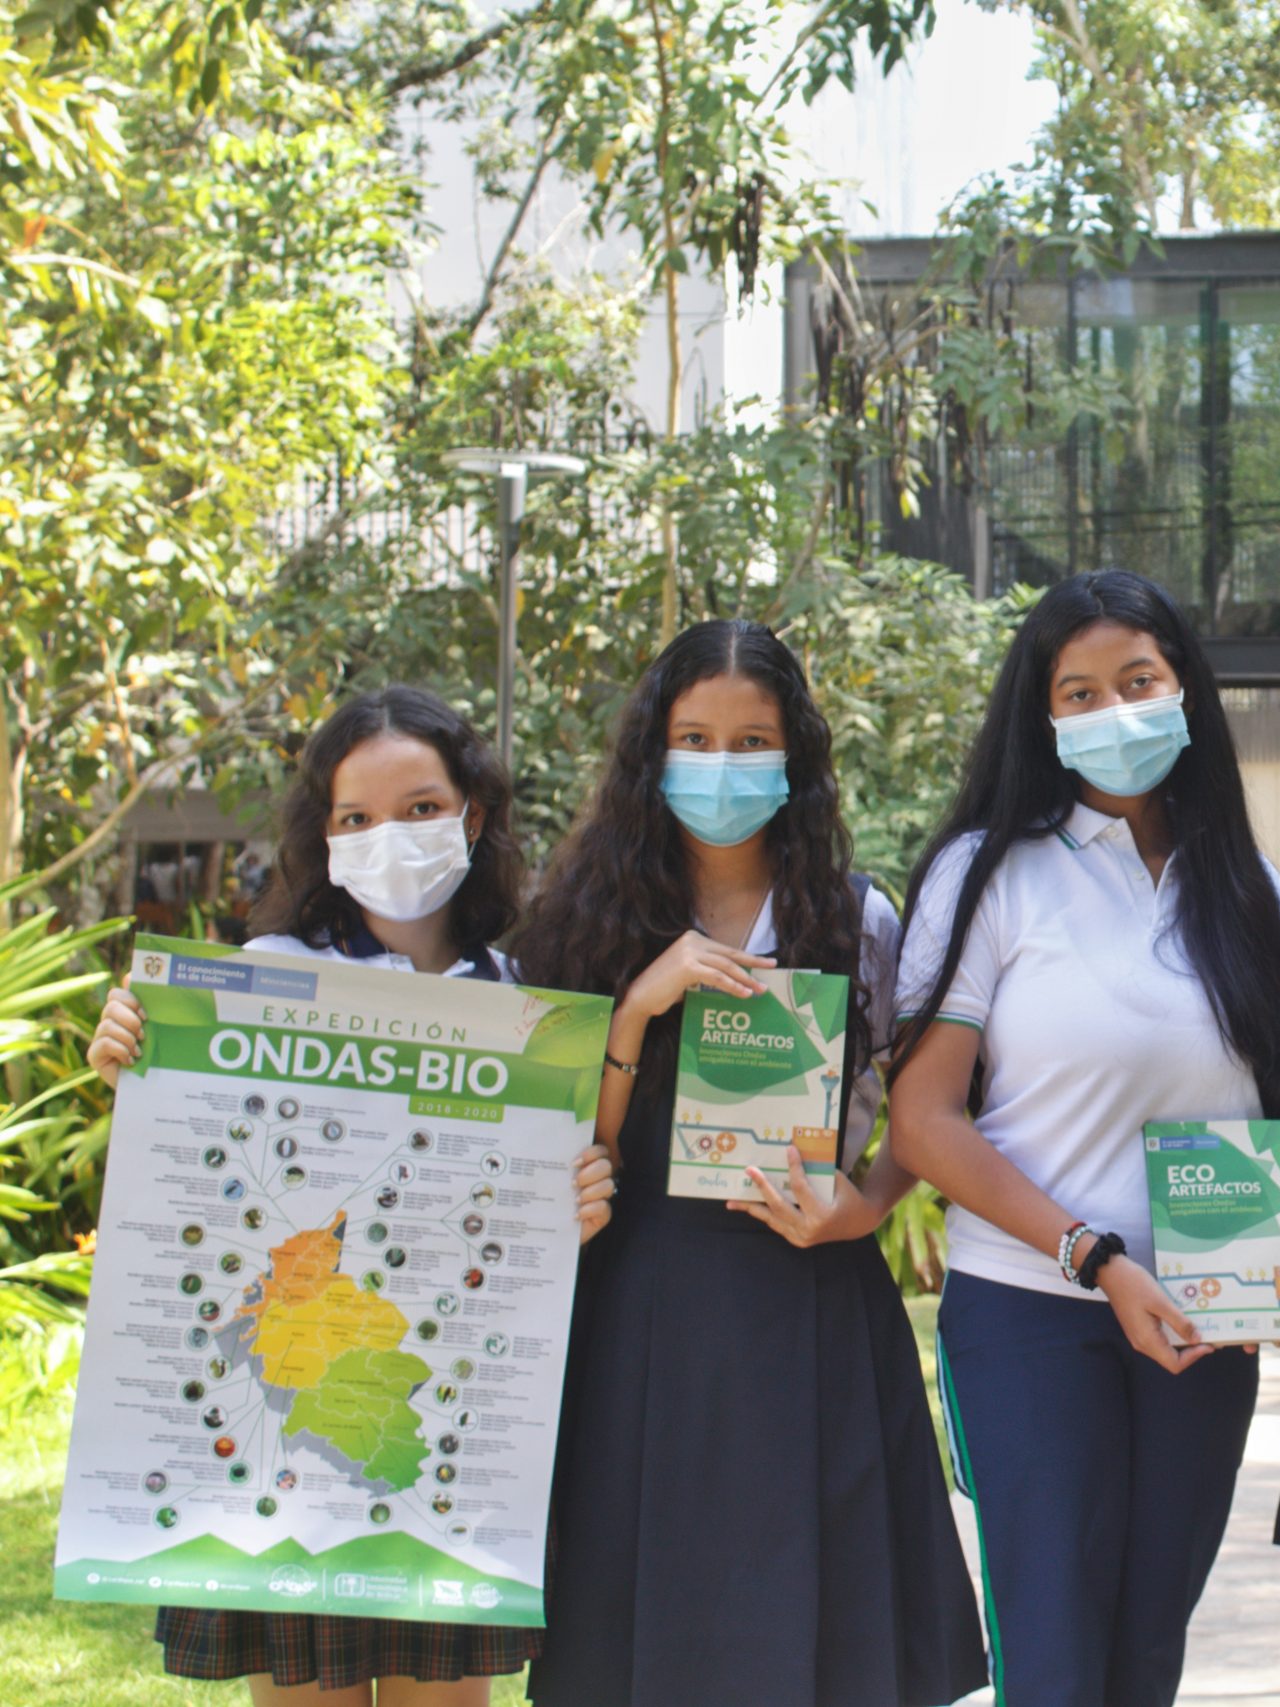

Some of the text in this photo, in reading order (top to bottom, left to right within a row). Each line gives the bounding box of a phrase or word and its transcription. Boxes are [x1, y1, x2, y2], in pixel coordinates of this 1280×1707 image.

[177, 963, 247, 979] El conocimiento
[188, 972, 200, 982] de
[201, 974, 227, 984] todos
[262, 1004, 468, 1043] EXPEDICIÓN
[703, 1008, 751, 1031] ECO
[701, 1030, 794, 1049] ARTEFACTOS
[208, 1028, 509, 1097] ONDAS-BIO
[1167, 1164, 1215, 1184] ECO
[1168, 1181, 1262, 1197] ARTEFACTOS
